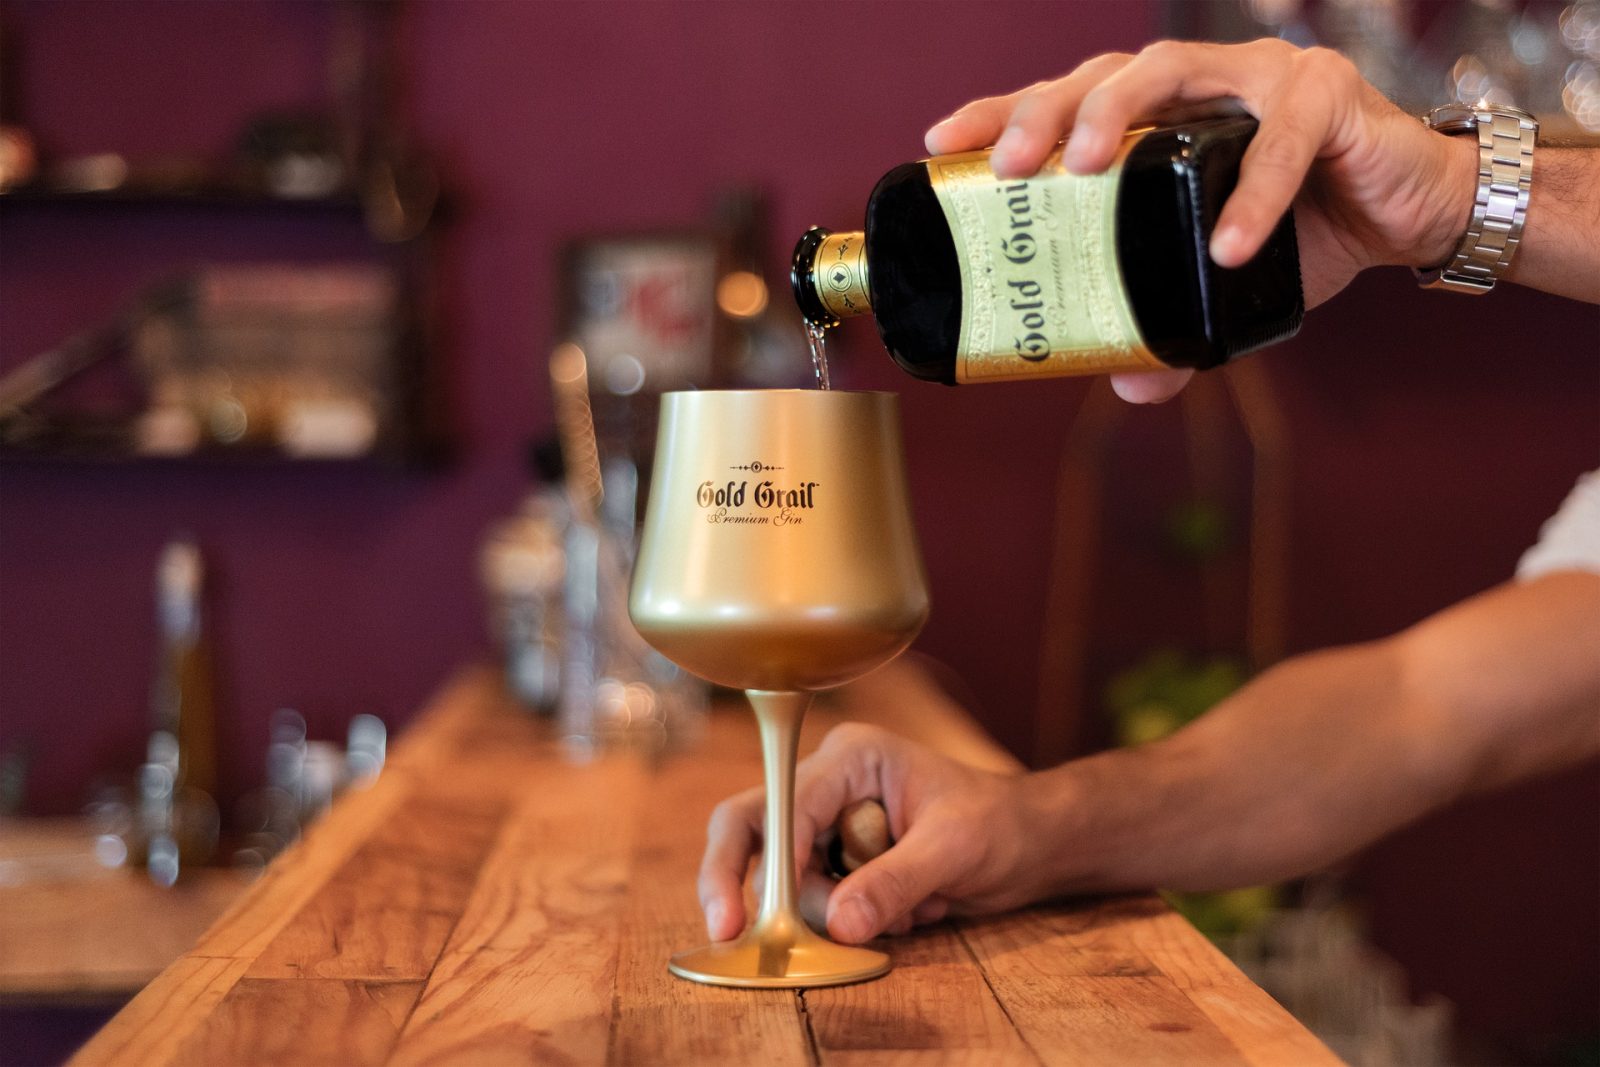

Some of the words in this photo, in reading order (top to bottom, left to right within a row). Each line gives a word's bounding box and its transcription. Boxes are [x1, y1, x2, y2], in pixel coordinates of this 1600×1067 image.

[997, 181, 1037, 264] Grai
[1034, 187, 1059, 232] Gin
[1008, 278, 1050, 362] Gold
[1048, 239, 1067, 338] Premium
[697, 481, 748, 508] Gold
[754, 480, 816, 508] Grail
[706, 507, 769, 524] Premium
[773, 507, 803, 526] Gin
